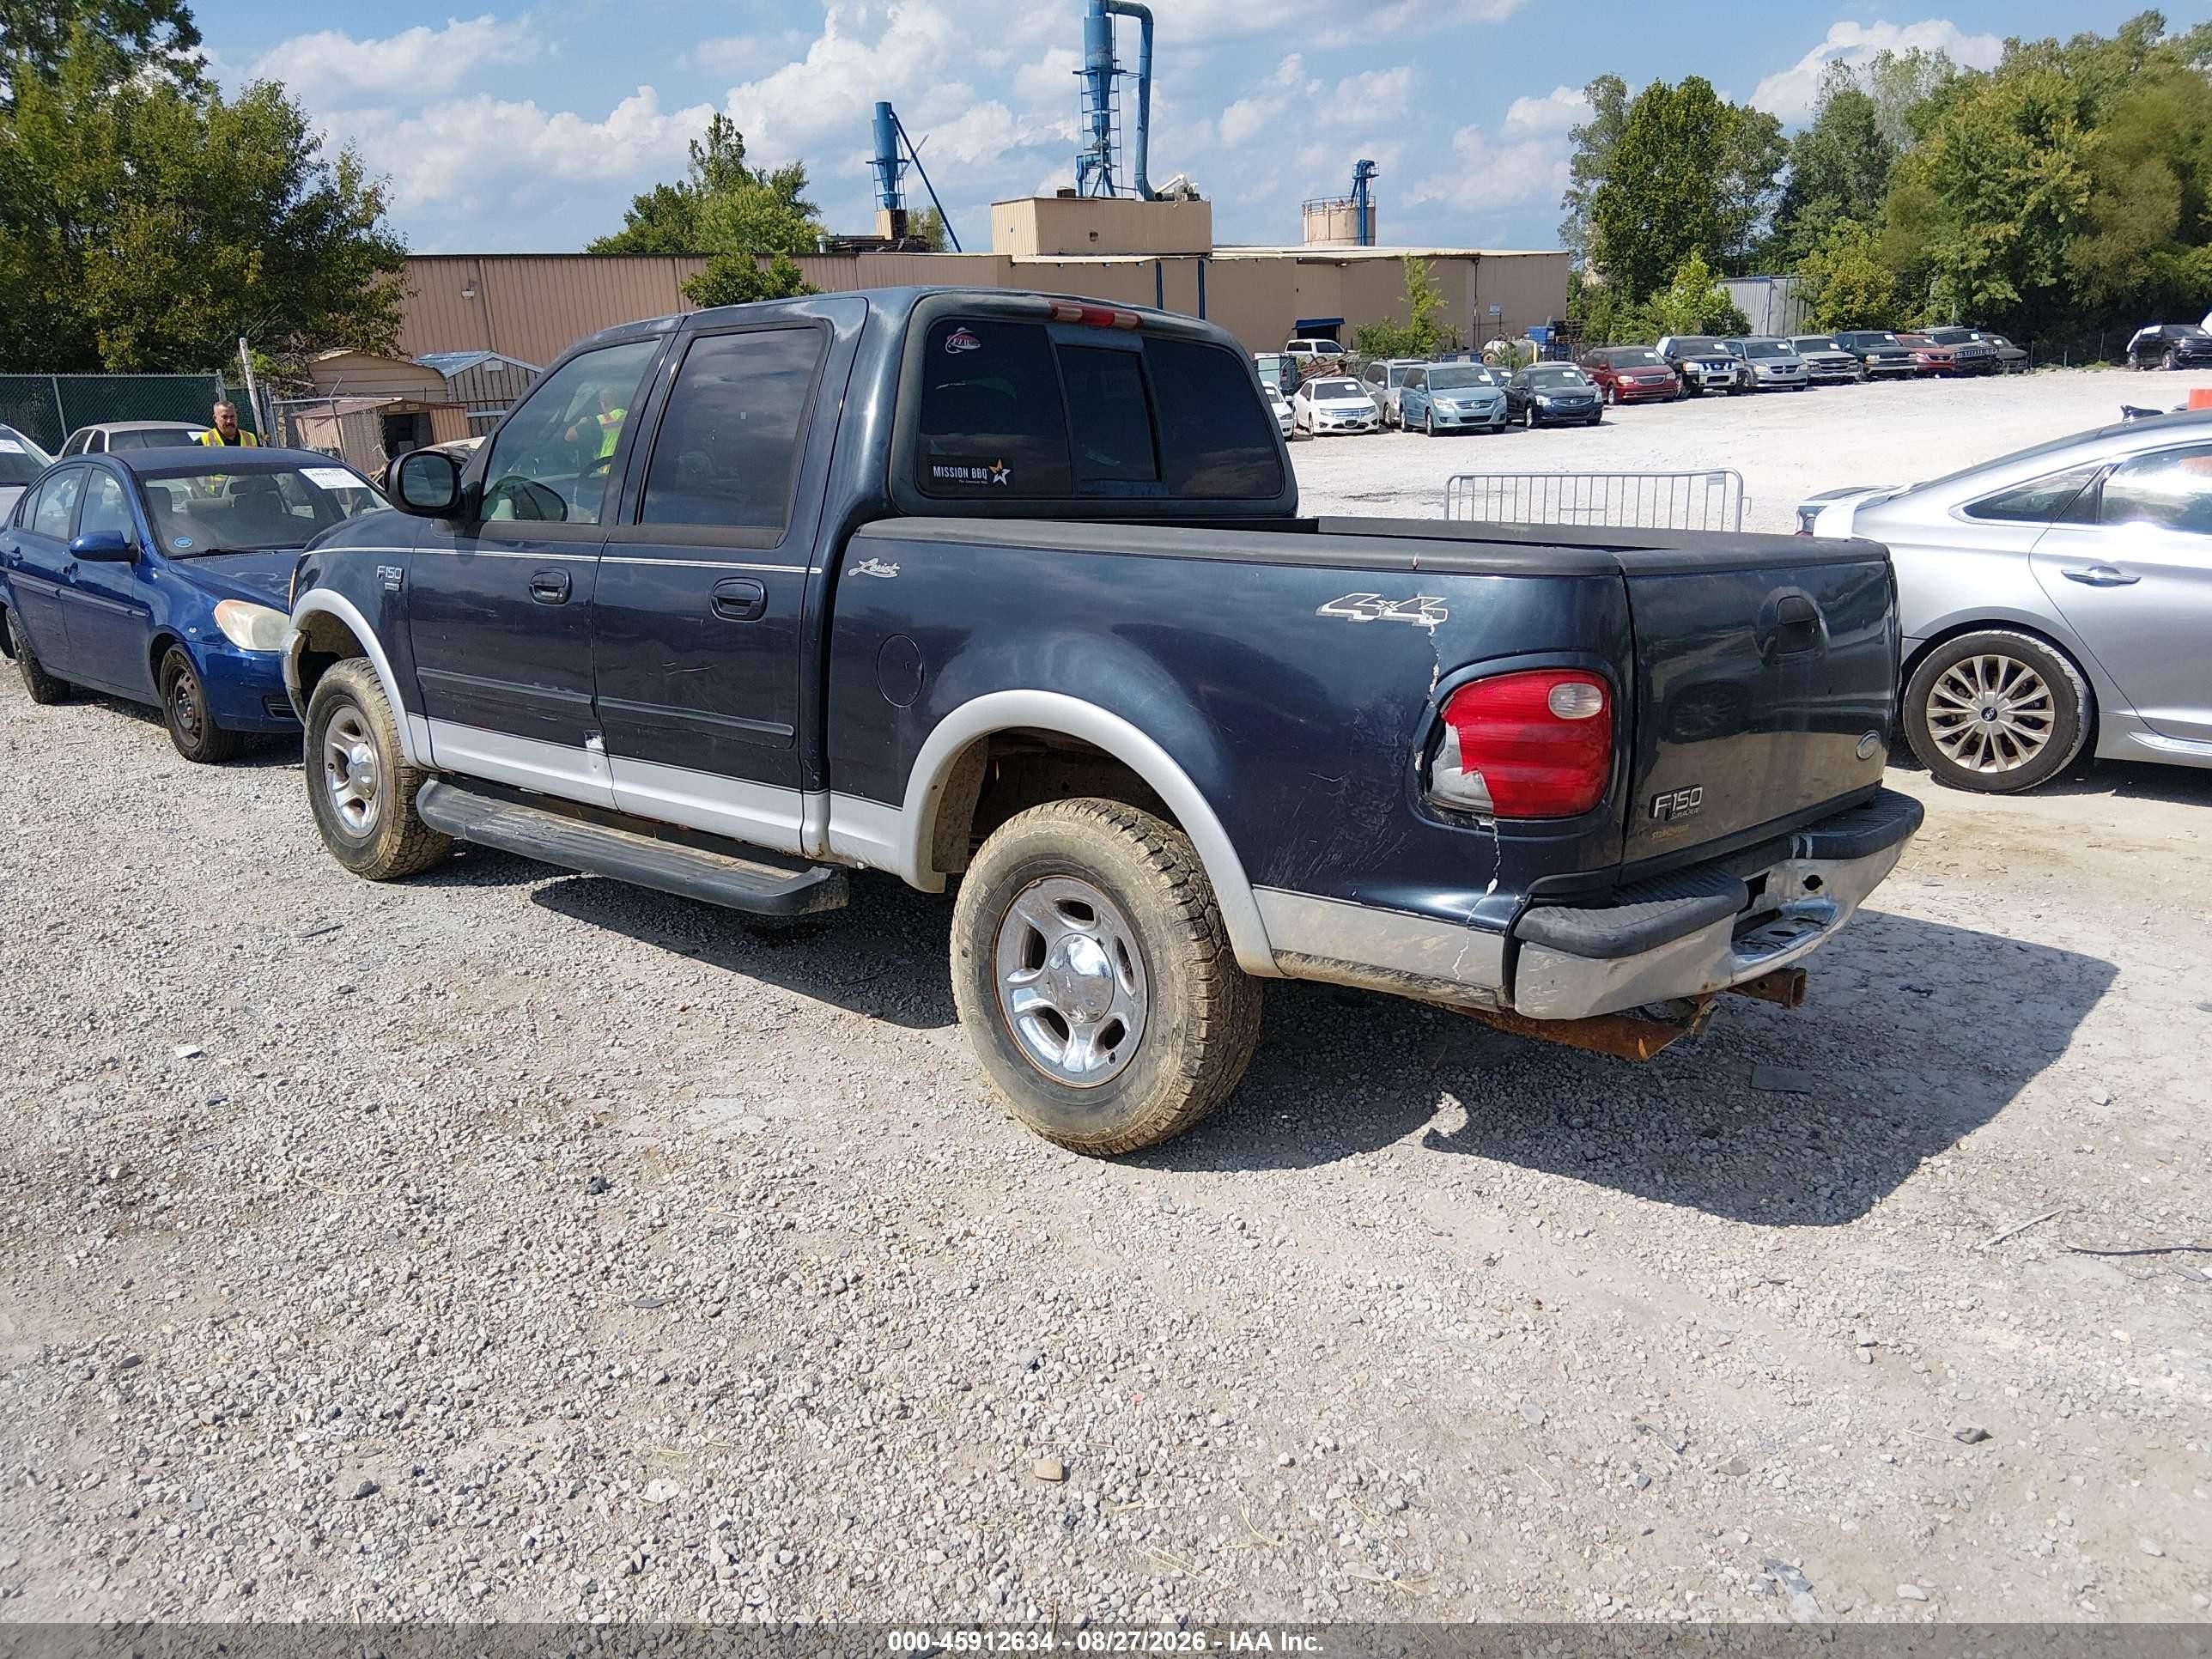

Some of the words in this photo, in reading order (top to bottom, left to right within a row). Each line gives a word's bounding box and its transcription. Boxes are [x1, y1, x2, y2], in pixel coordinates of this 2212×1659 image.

[933, 465, 969, 479] MISSION
[971, 467, 988, 481] BBQ
[376, 565, 403, 580] F150
[1653, 787, 1703, 818] F150
